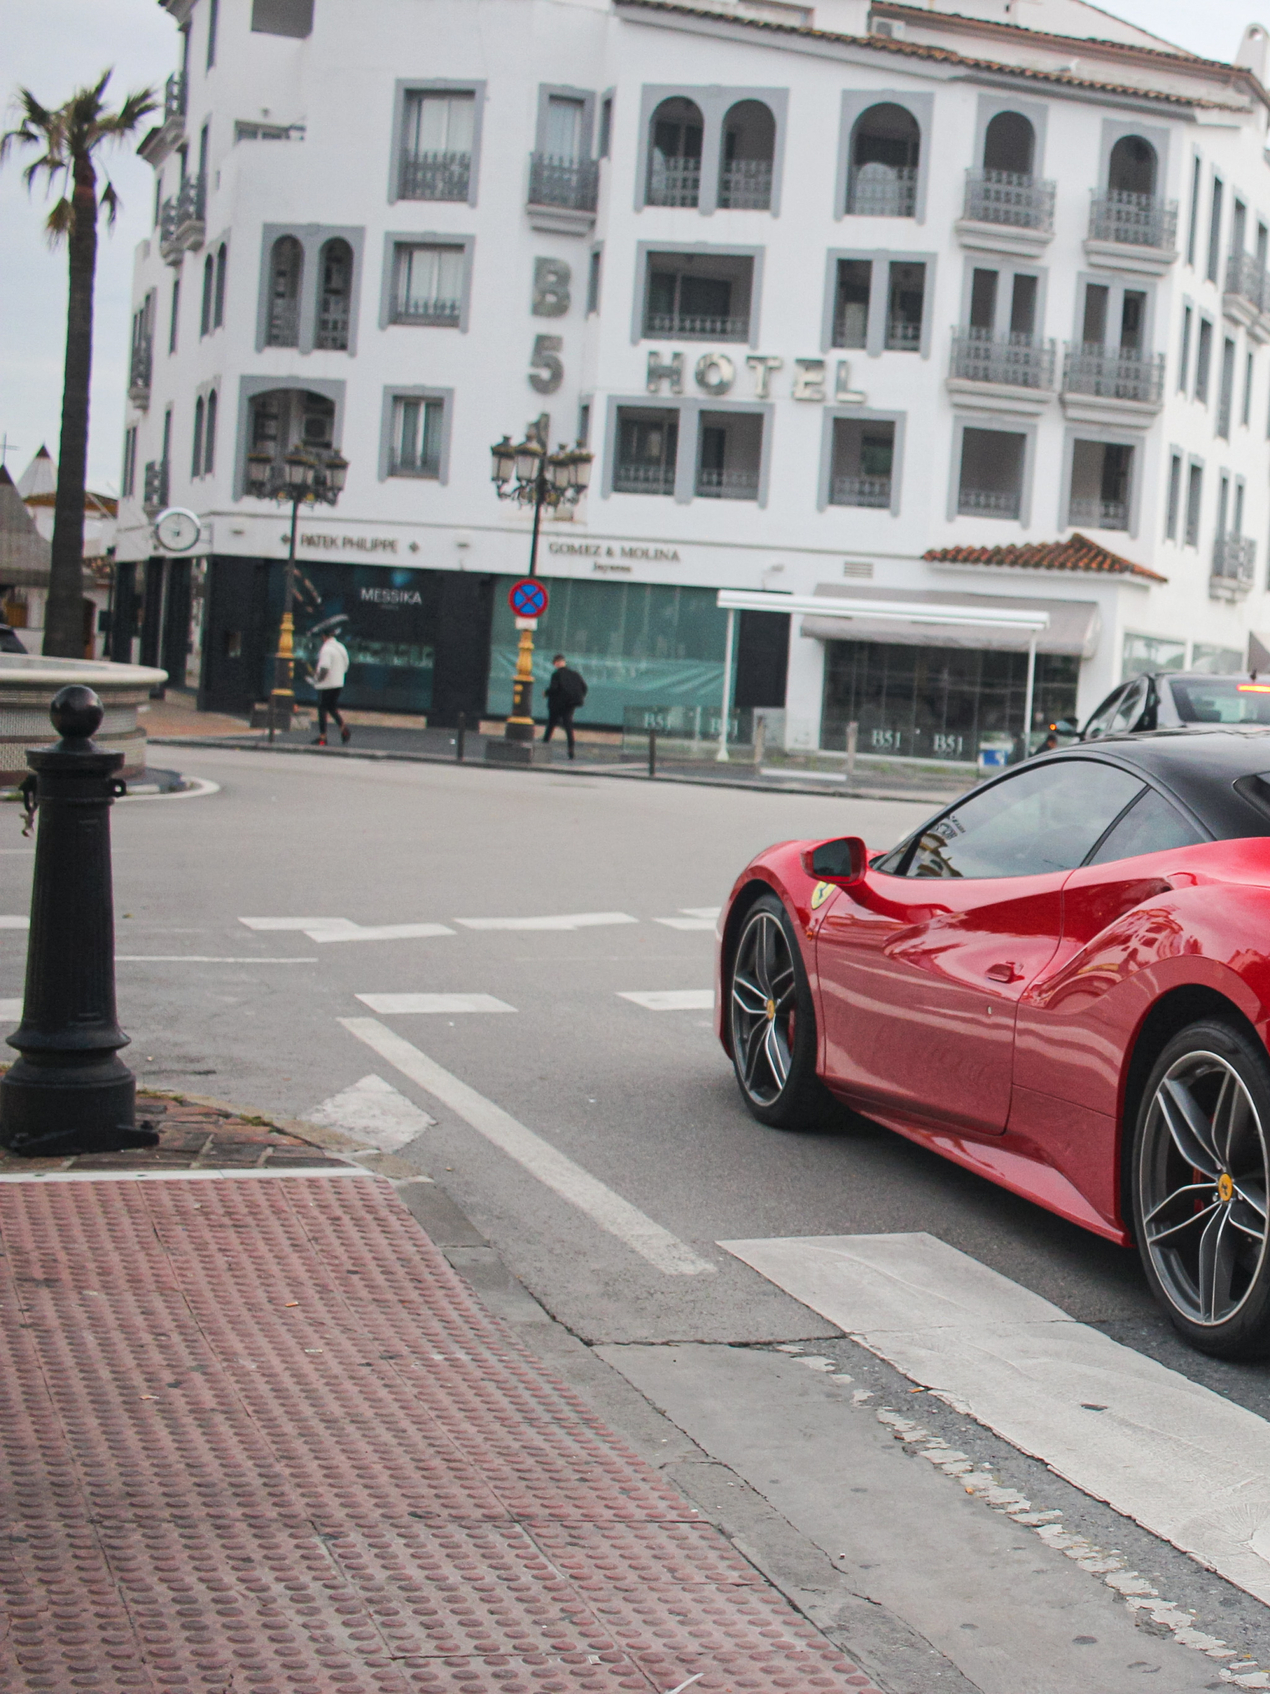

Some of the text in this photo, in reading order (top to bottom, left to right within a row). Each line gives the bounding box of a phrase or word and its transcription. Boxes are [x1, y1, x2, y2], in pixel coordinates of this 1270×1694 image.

[646, 351, 867, 403] HOTEL
[300, 533, 399, 553] PATEK PHILIPPE
[549, 541, 681, 563] GOMEZ & MOLINA
[360, 586, 422, 605] MESSIKA
